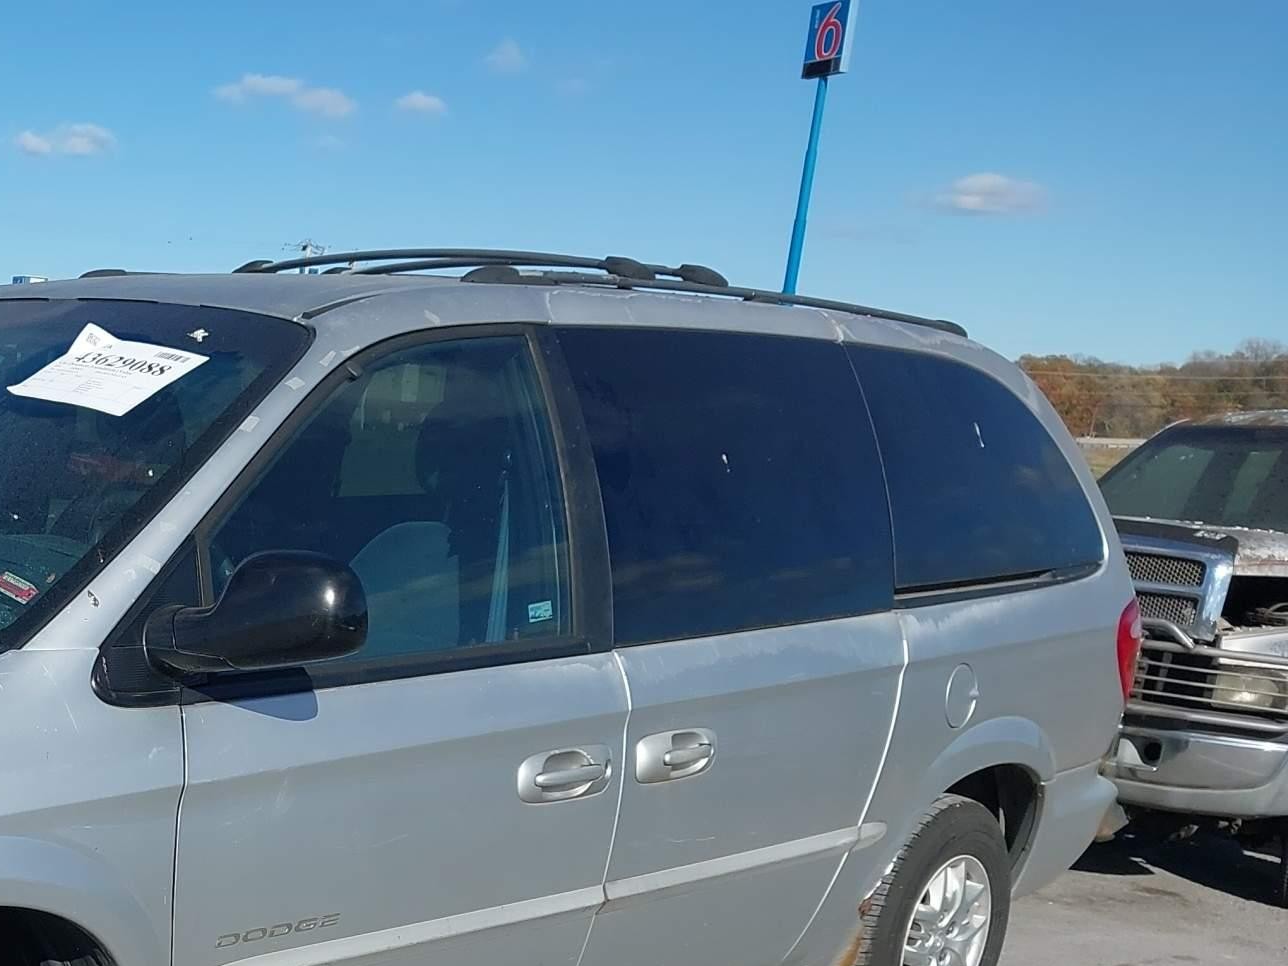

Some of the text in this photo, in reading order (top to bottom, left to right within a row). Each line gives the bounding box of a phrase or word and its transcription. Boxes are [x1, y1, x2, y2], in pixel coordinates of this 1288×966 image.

[815, 2, 843, 62] 6
[74, 351, 172, 376] 43629088
[215, 912, 341, 948] DODGE
